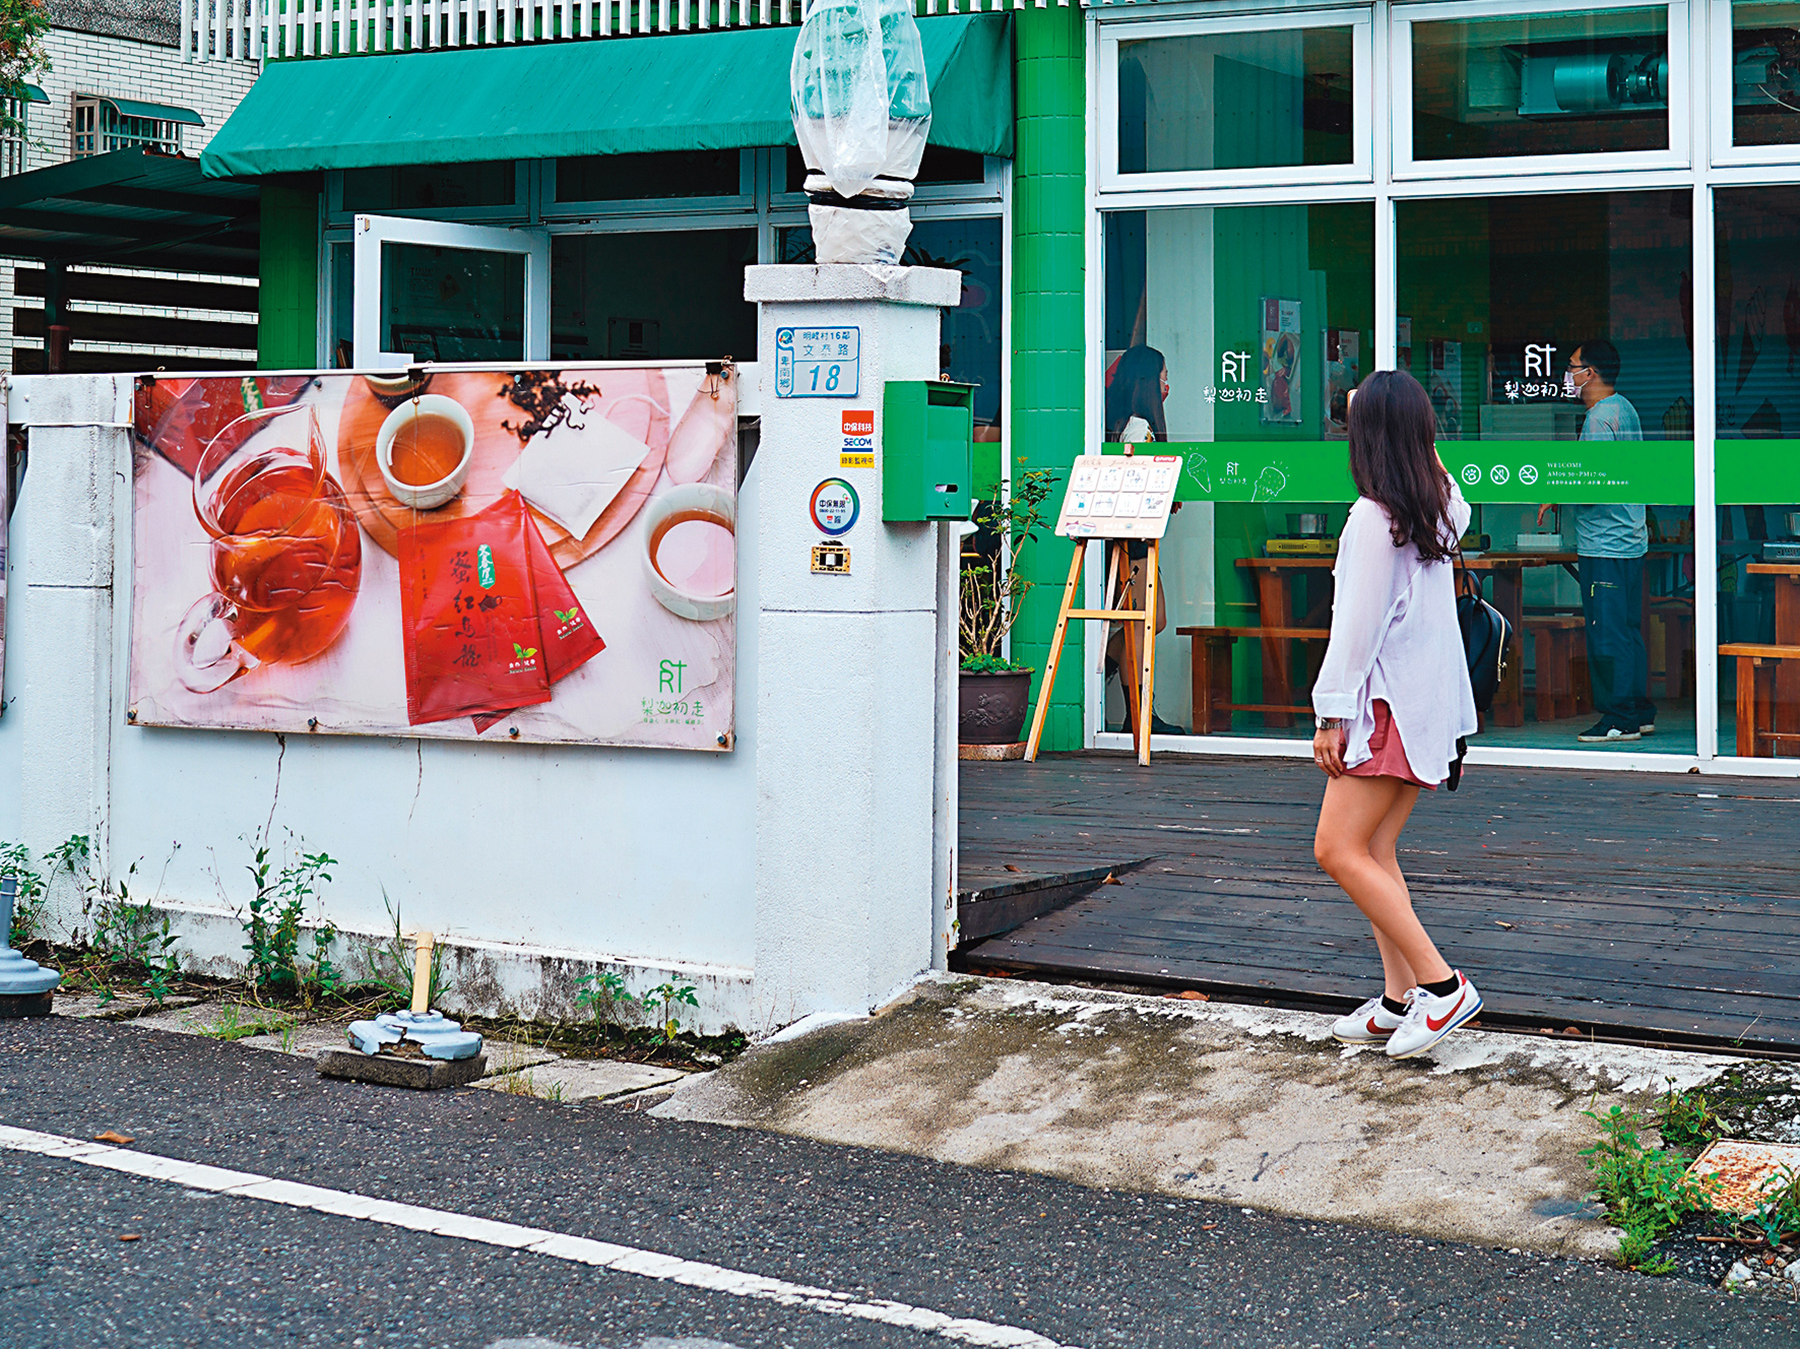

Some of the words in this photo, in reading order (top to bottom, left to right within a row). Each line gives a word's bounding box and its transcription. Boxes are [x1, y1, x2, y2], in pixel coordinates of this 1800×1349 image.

[809, 364, 840, 391] 18
[1203, 386, 1268, 404] 梨迦初走
[1504, 380, 1577, 400] 梨迦初走
[843, 437, 872, 446] SECOM
[642, 696, 704, 717] 梨迦初走
